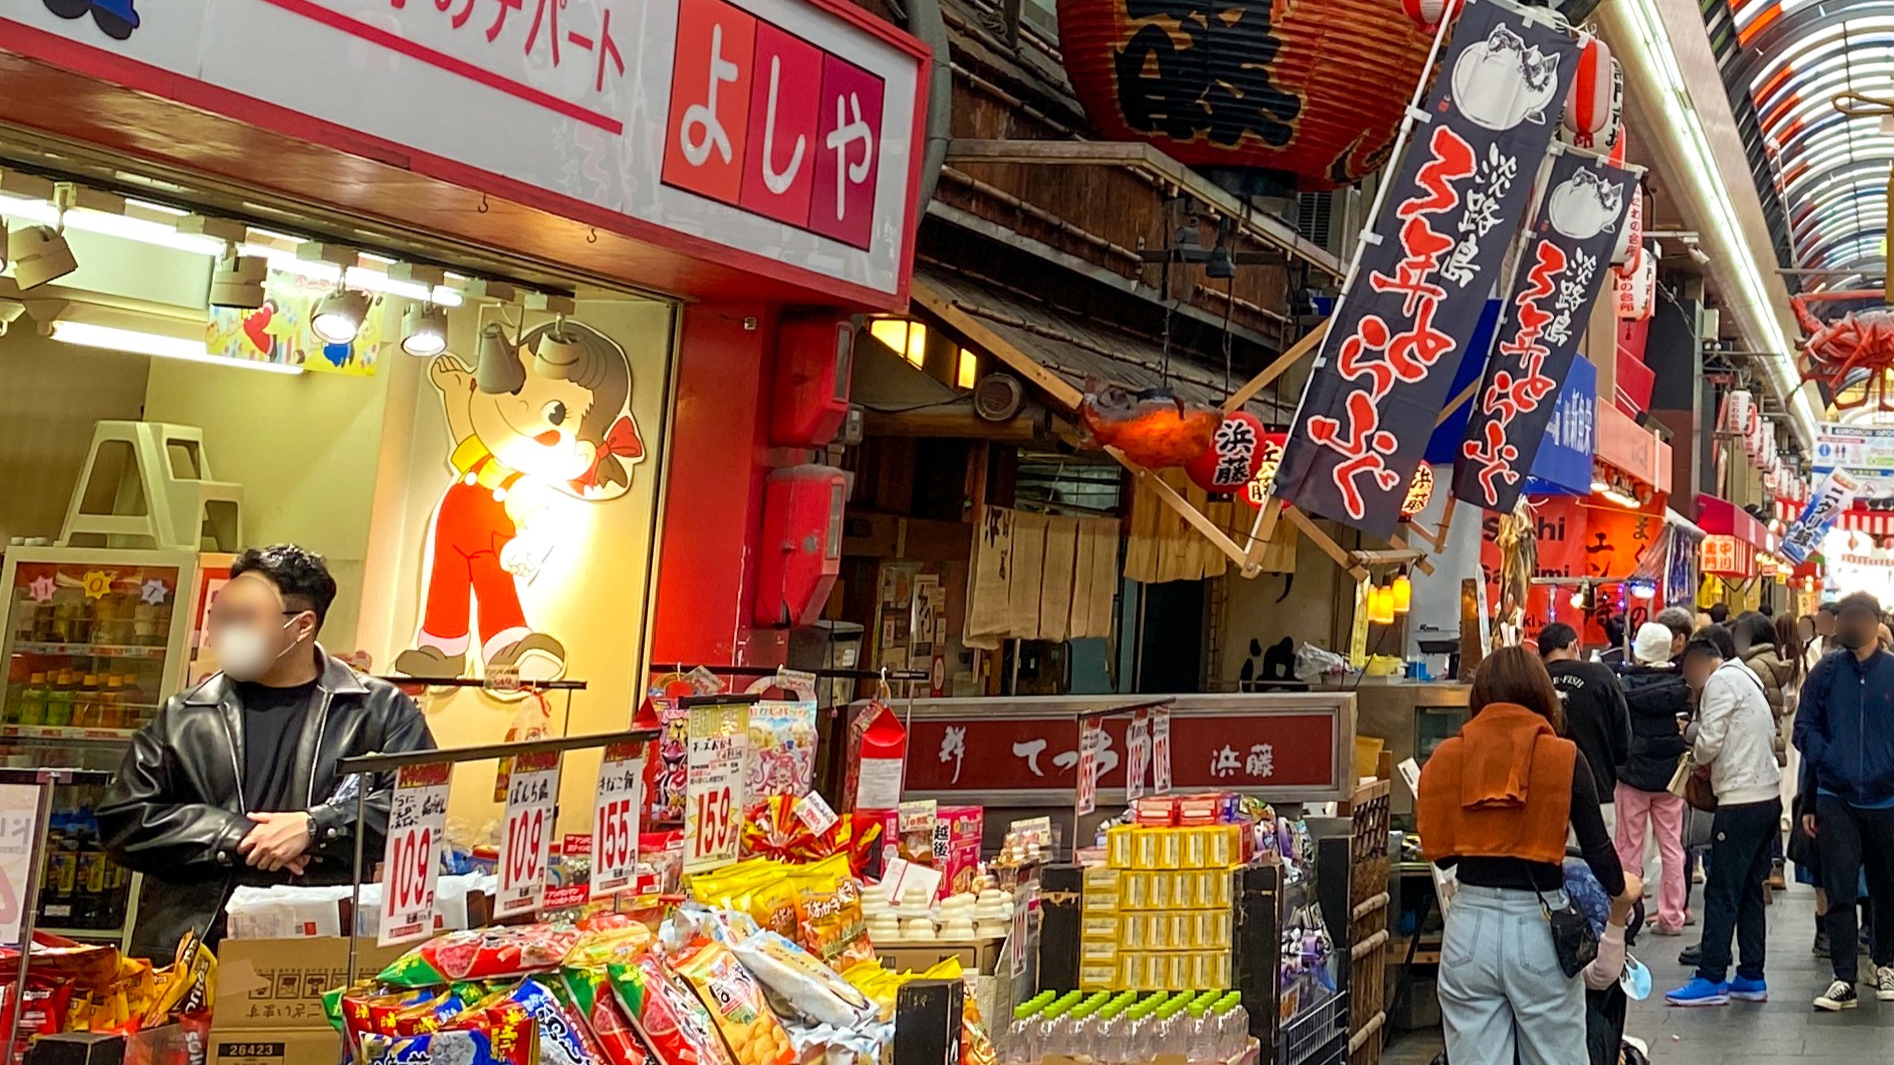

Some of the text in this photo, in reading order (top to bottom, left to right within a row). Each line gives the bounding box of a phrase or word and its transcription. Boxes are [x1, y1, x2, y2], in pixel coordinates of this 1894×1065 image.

[680, 23, 874, 222] よしや
[1440, 141, 1520, 290] 淡路島
[1543, 246, 1605, 347] 淡路島
[1214, 420, 1256, 485] 浜藤
[1482, 516, 1566, 542] Shi
[1482, 564, 1570, 585] Saimi
[1210, 743, 1275, 778] 浜藤
[933, 824, 949, 858] 越後
[229, 1044, 275, 1057] 26423
